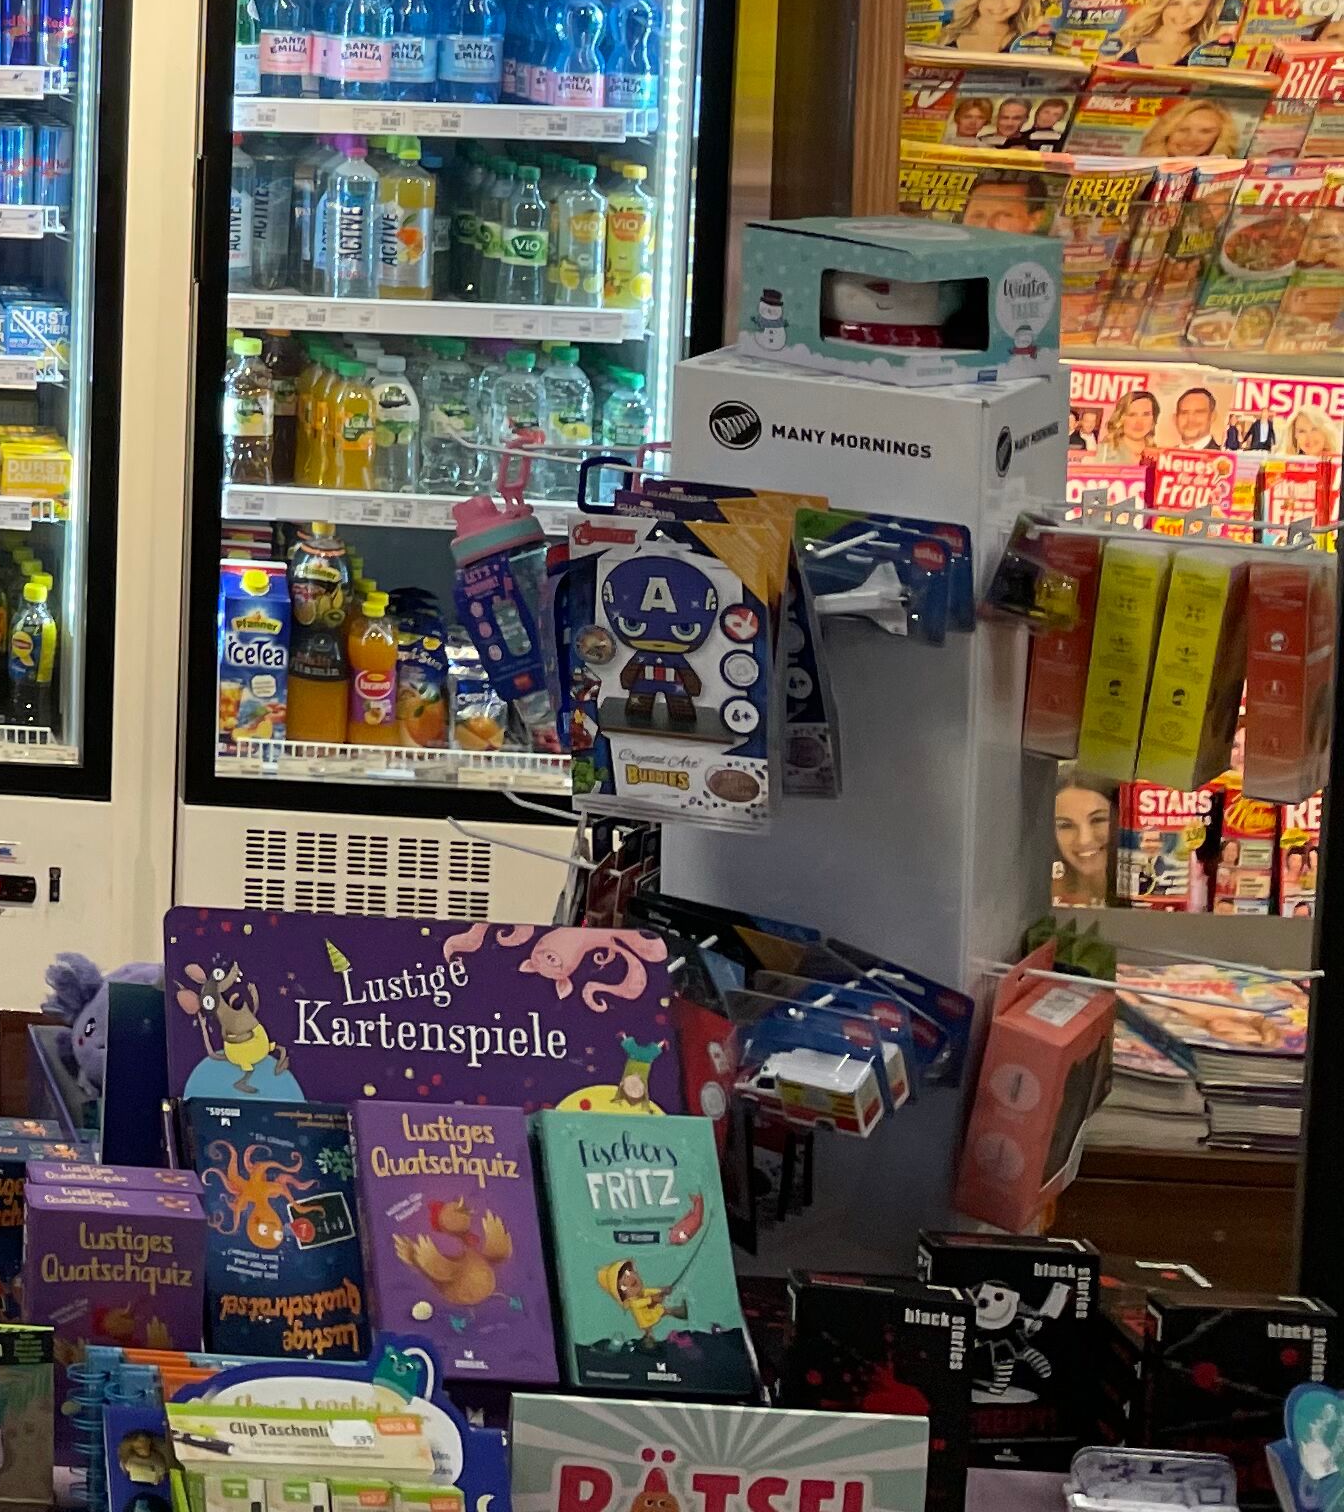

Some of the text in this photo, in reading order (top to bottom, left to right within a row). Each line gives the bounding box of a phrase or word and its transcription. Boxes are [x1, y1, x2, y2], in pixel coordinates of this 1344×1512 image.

[772, 424, 932, 460] MANY MORNINGS
[6, 459, 68, 473] DURST
[1157, 457, 1214, 475] Neues
[640, 577, 678, 613] A
[625, 764, 691, 790] BUDDIES
[1139, 789, 1212, 815] STARS
[342, 957, 469, 1008] Lustige
[293, 999, 568, 1068] Kartenspiele
[401, 1114, 495, 1155] Lustiges
[577, 1129, 678, 1169] Fischers
[370, 1144, 521, 1188] Quatschquiz
[79, 1222, 174, 1263] Lustiges
[41, 1254, 193, 1296] Quatschquiz
[1034, 1262, 1076, 1278] black
[219, 1277, 361, 1325] Quatschrätsel
[1075, 1266, 1091, 1319] stories
[905, 1308, 950, 1327] black
[1267, 1322, 1311, 1340] black
[283, 1320, 360, 1356] Lustige
[949, 1315, 966, 1370] stories
[229, 1422, 258, 1438] Clip
